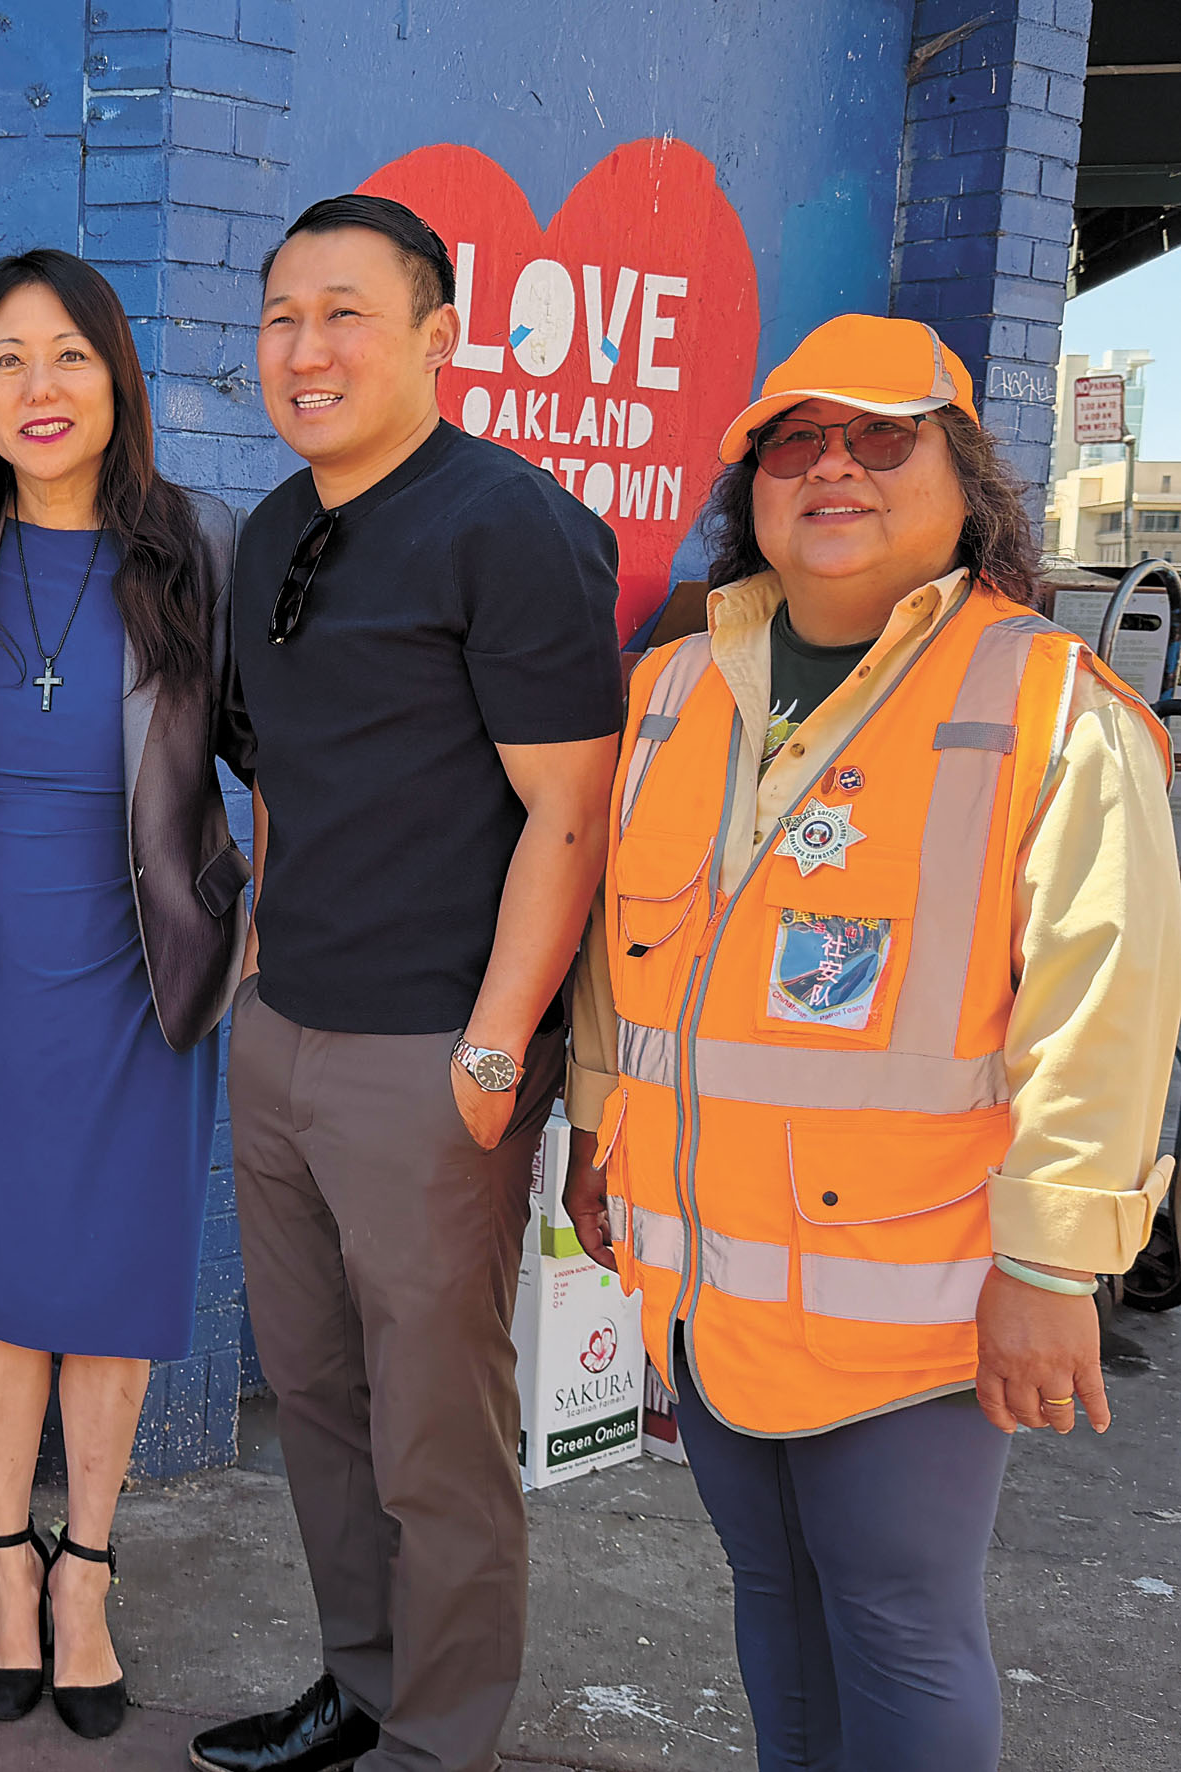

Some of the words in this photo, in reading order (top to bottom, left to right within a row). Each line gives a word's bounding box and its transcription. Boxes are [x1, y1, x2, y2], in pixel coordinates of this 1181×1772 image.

[452, 242, 688, 391] LOVE
[461, 386, 654, 449] OAKLAND
[805, 934, 847, 1007] 社安队
[842, 1004, 865, 1015] Team
[555, 1370, 634, 1411] SAKURA
[567, 1404, 597, 1417] Scallion
[551, 1435, 593, 1457] Green
[595, 1419, 636, 1443] Onions
